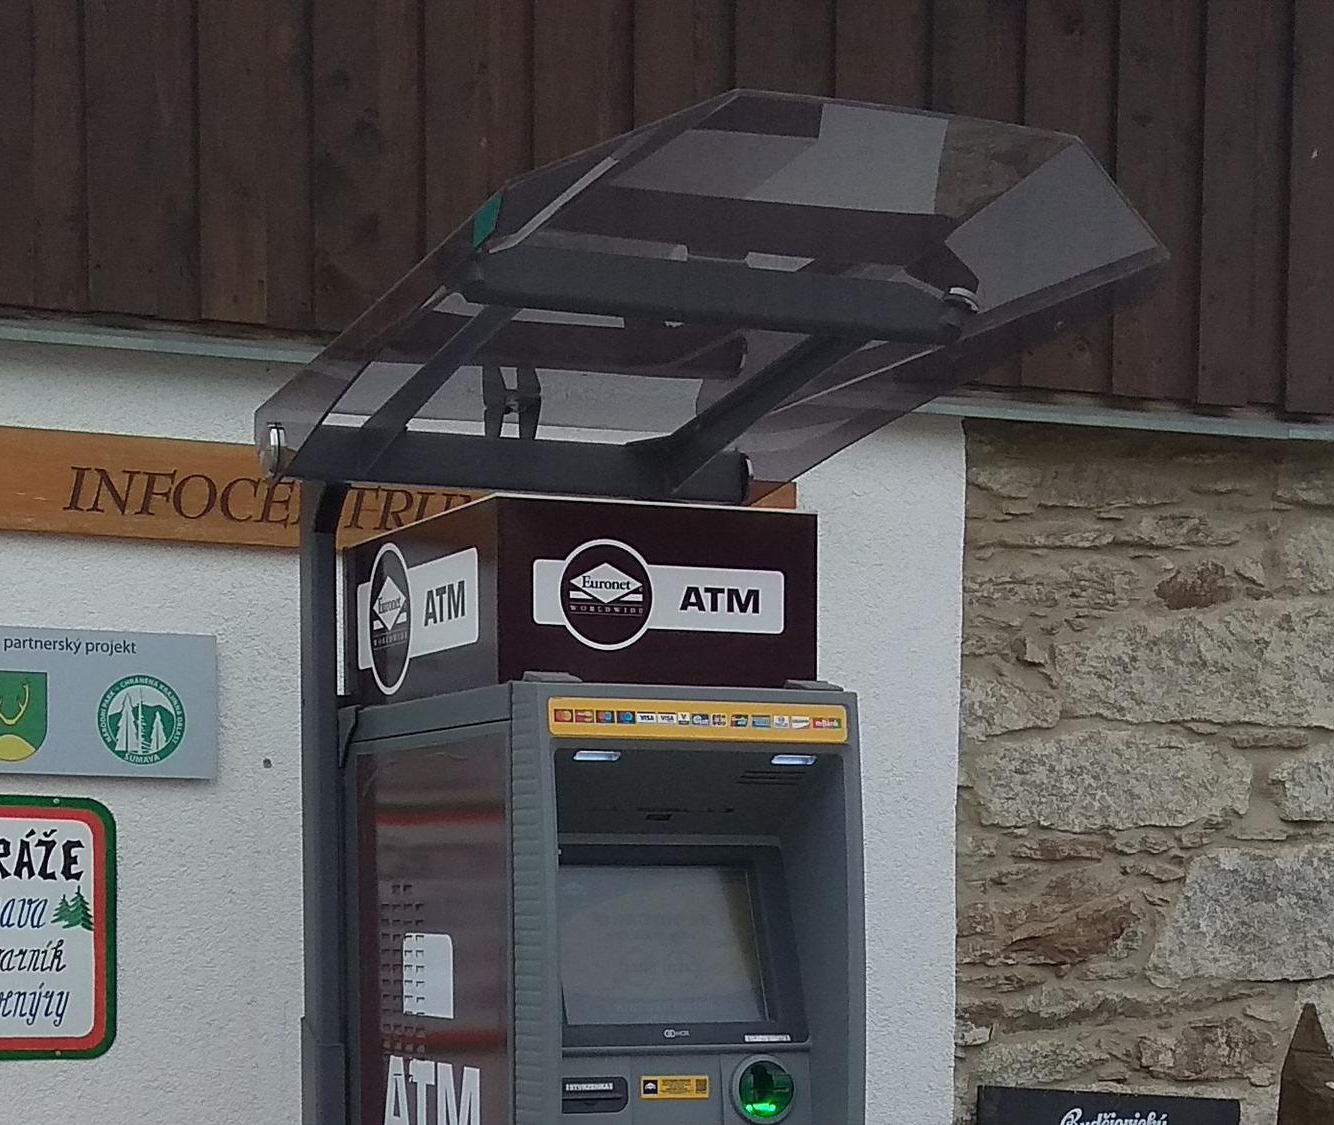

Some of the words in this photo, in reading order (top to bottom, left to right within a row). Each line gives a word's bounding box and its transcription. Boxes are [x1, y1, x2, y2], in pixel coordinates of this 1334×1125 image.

[582, 575, 631, 591] Euronet
[424, 579, 466, 627] ATM
[570, 604, 643, 614] WORLDWIDE
[679, 585, 760, 615] ATM
[3, 636, 81, 654] partnerský
[85, 639, 136, 657] projekt
